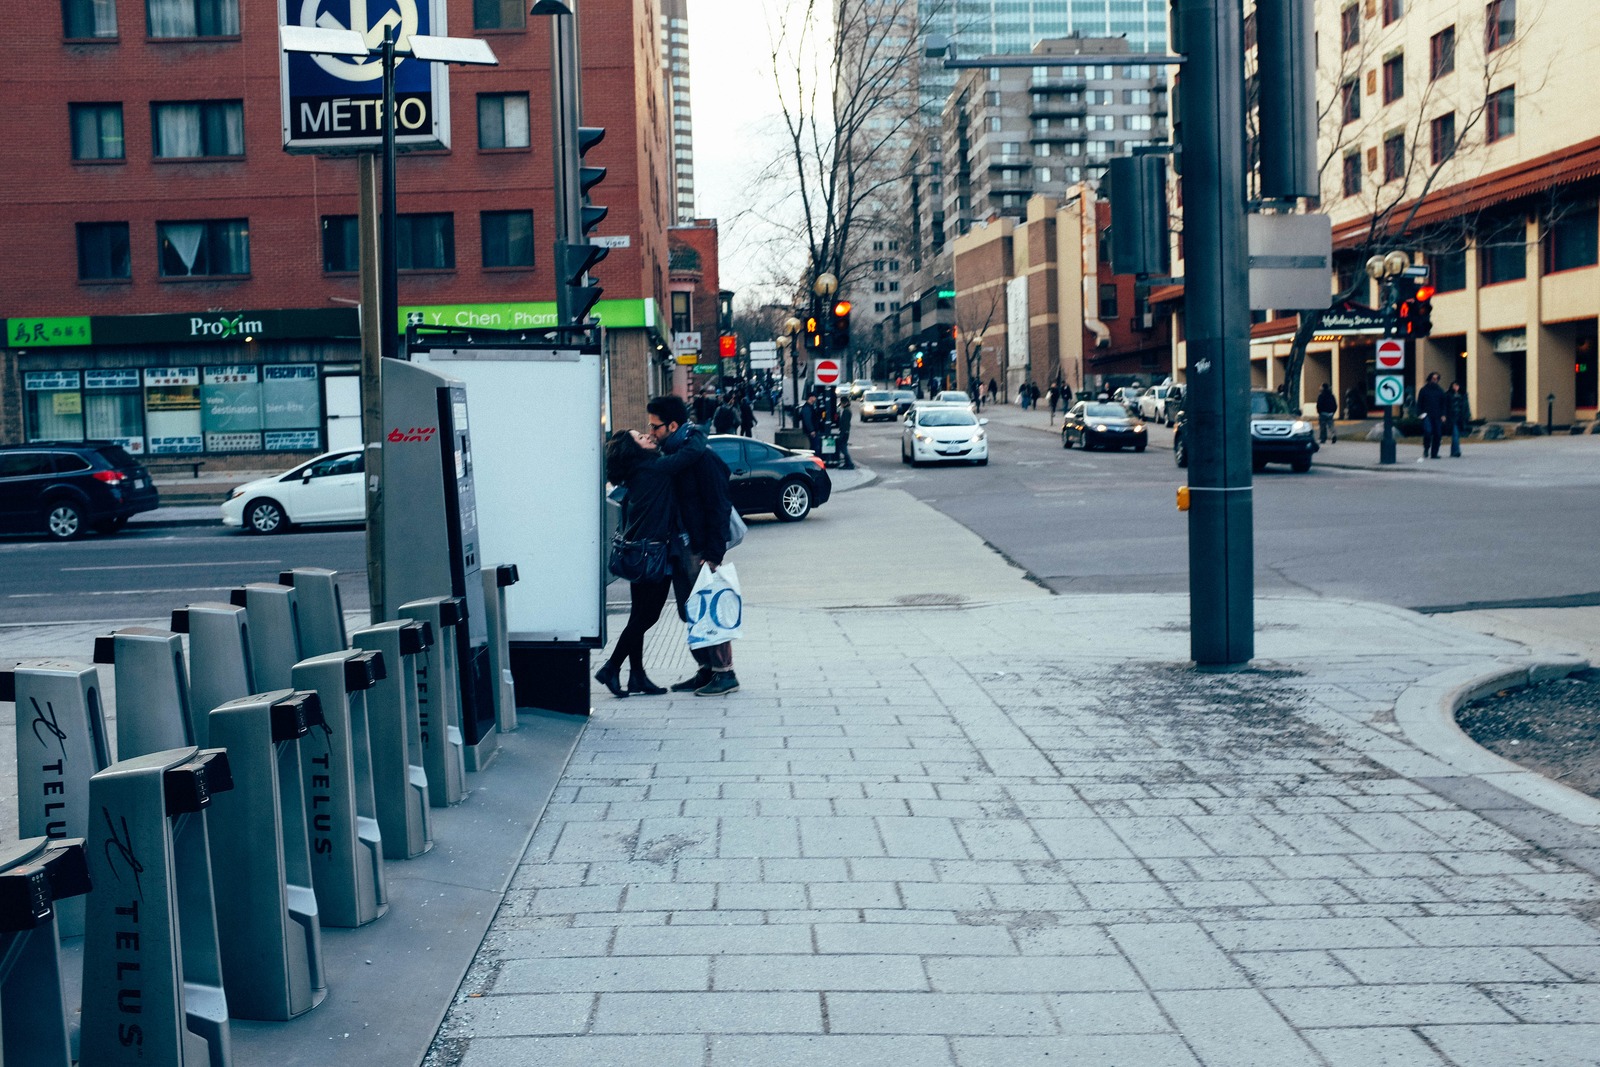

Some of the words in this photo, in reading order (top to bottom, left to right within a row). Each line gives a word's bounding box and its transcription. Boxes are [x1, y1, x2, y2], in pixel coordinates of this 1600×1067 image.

[432, 312, 447, 327] Y.
[455, 311, 501, 326] Chen
[211, 405, 258, 415] destination
[42, 759, 67, 838] TELU
[312, 753, 332, 854] TELUS
[115, 901, 144, 1047] TELUS
